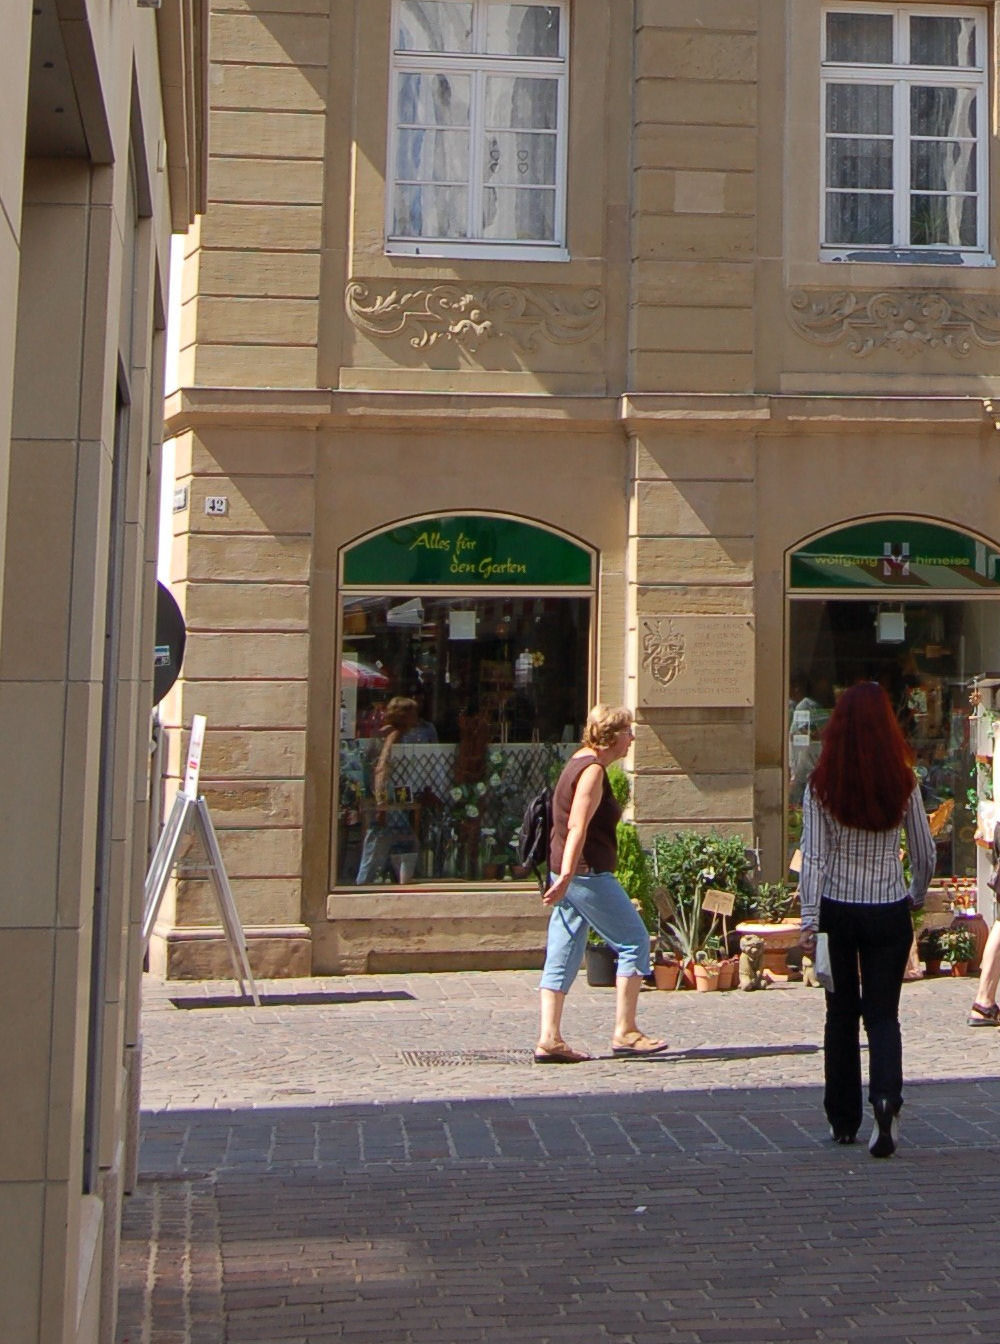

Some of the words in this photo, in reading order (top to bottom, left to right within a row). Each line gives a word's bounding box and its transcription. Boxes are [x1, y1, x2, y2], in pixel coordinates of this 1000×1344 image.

[208, 499, 224, 512] 42
[409, 532, 450, 551] Alles
[456, 533, 477, 555] für
[450, 554, 475, 573] den
[479, 557, 526, 578] Garten
[815, 553, 878, 567] wolfgang
